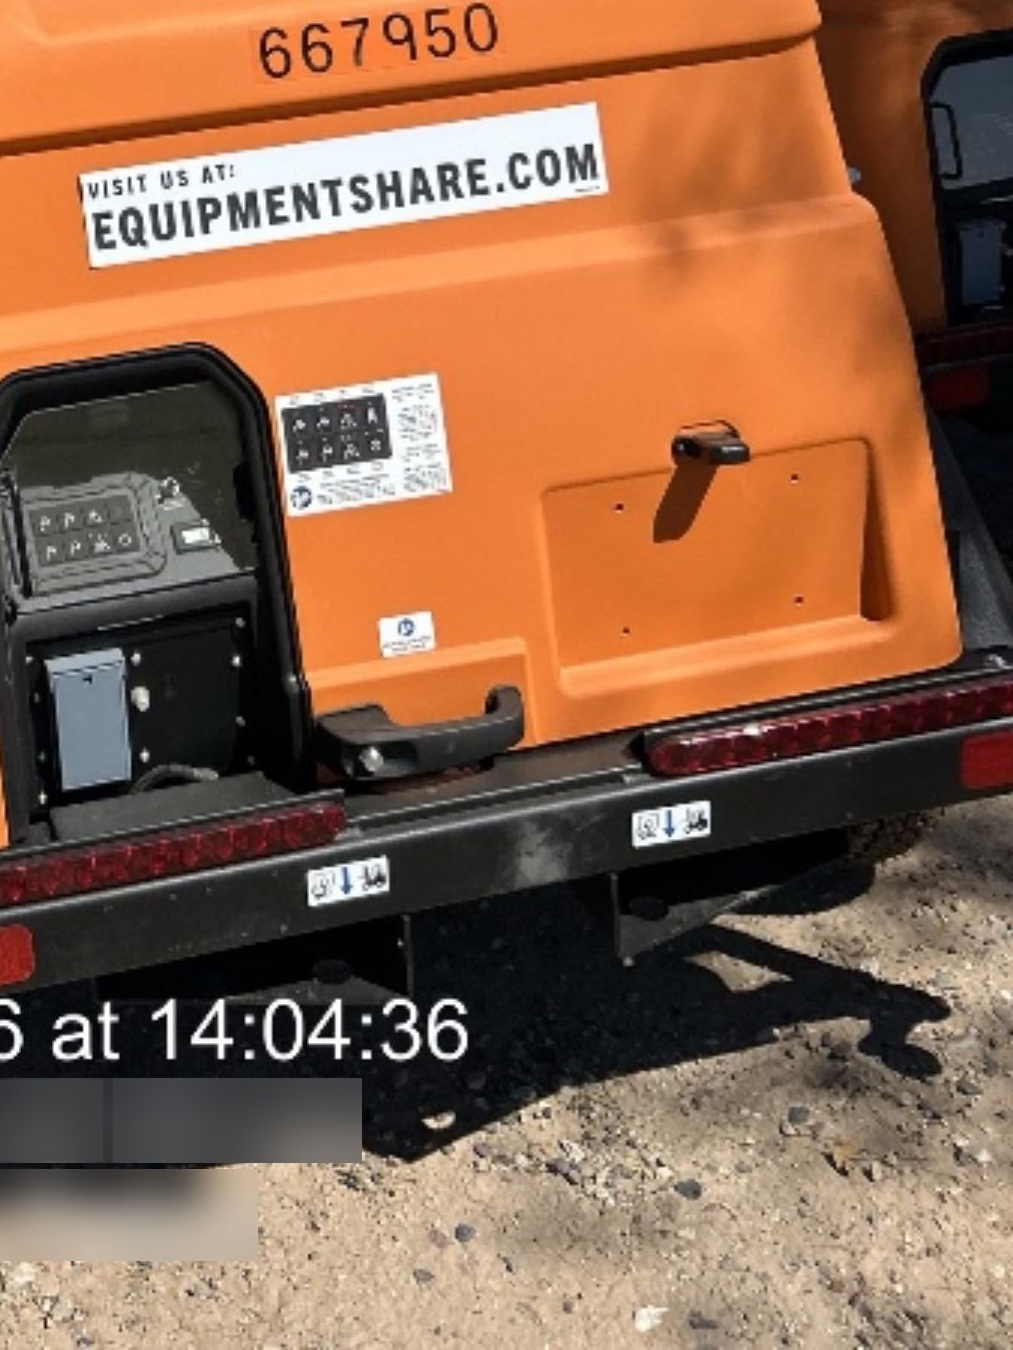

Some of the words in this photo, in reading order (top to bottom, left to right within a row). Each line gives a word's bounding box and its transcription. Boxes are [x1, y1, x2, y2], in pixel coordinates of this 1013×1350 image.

[258, 2, 499, 79] 667950
[88, 173, 147, 200] VISIT
[160, 168, 189, 190] US
[91, 142, 599, 251] EQUIPMENTSHARE.COM
